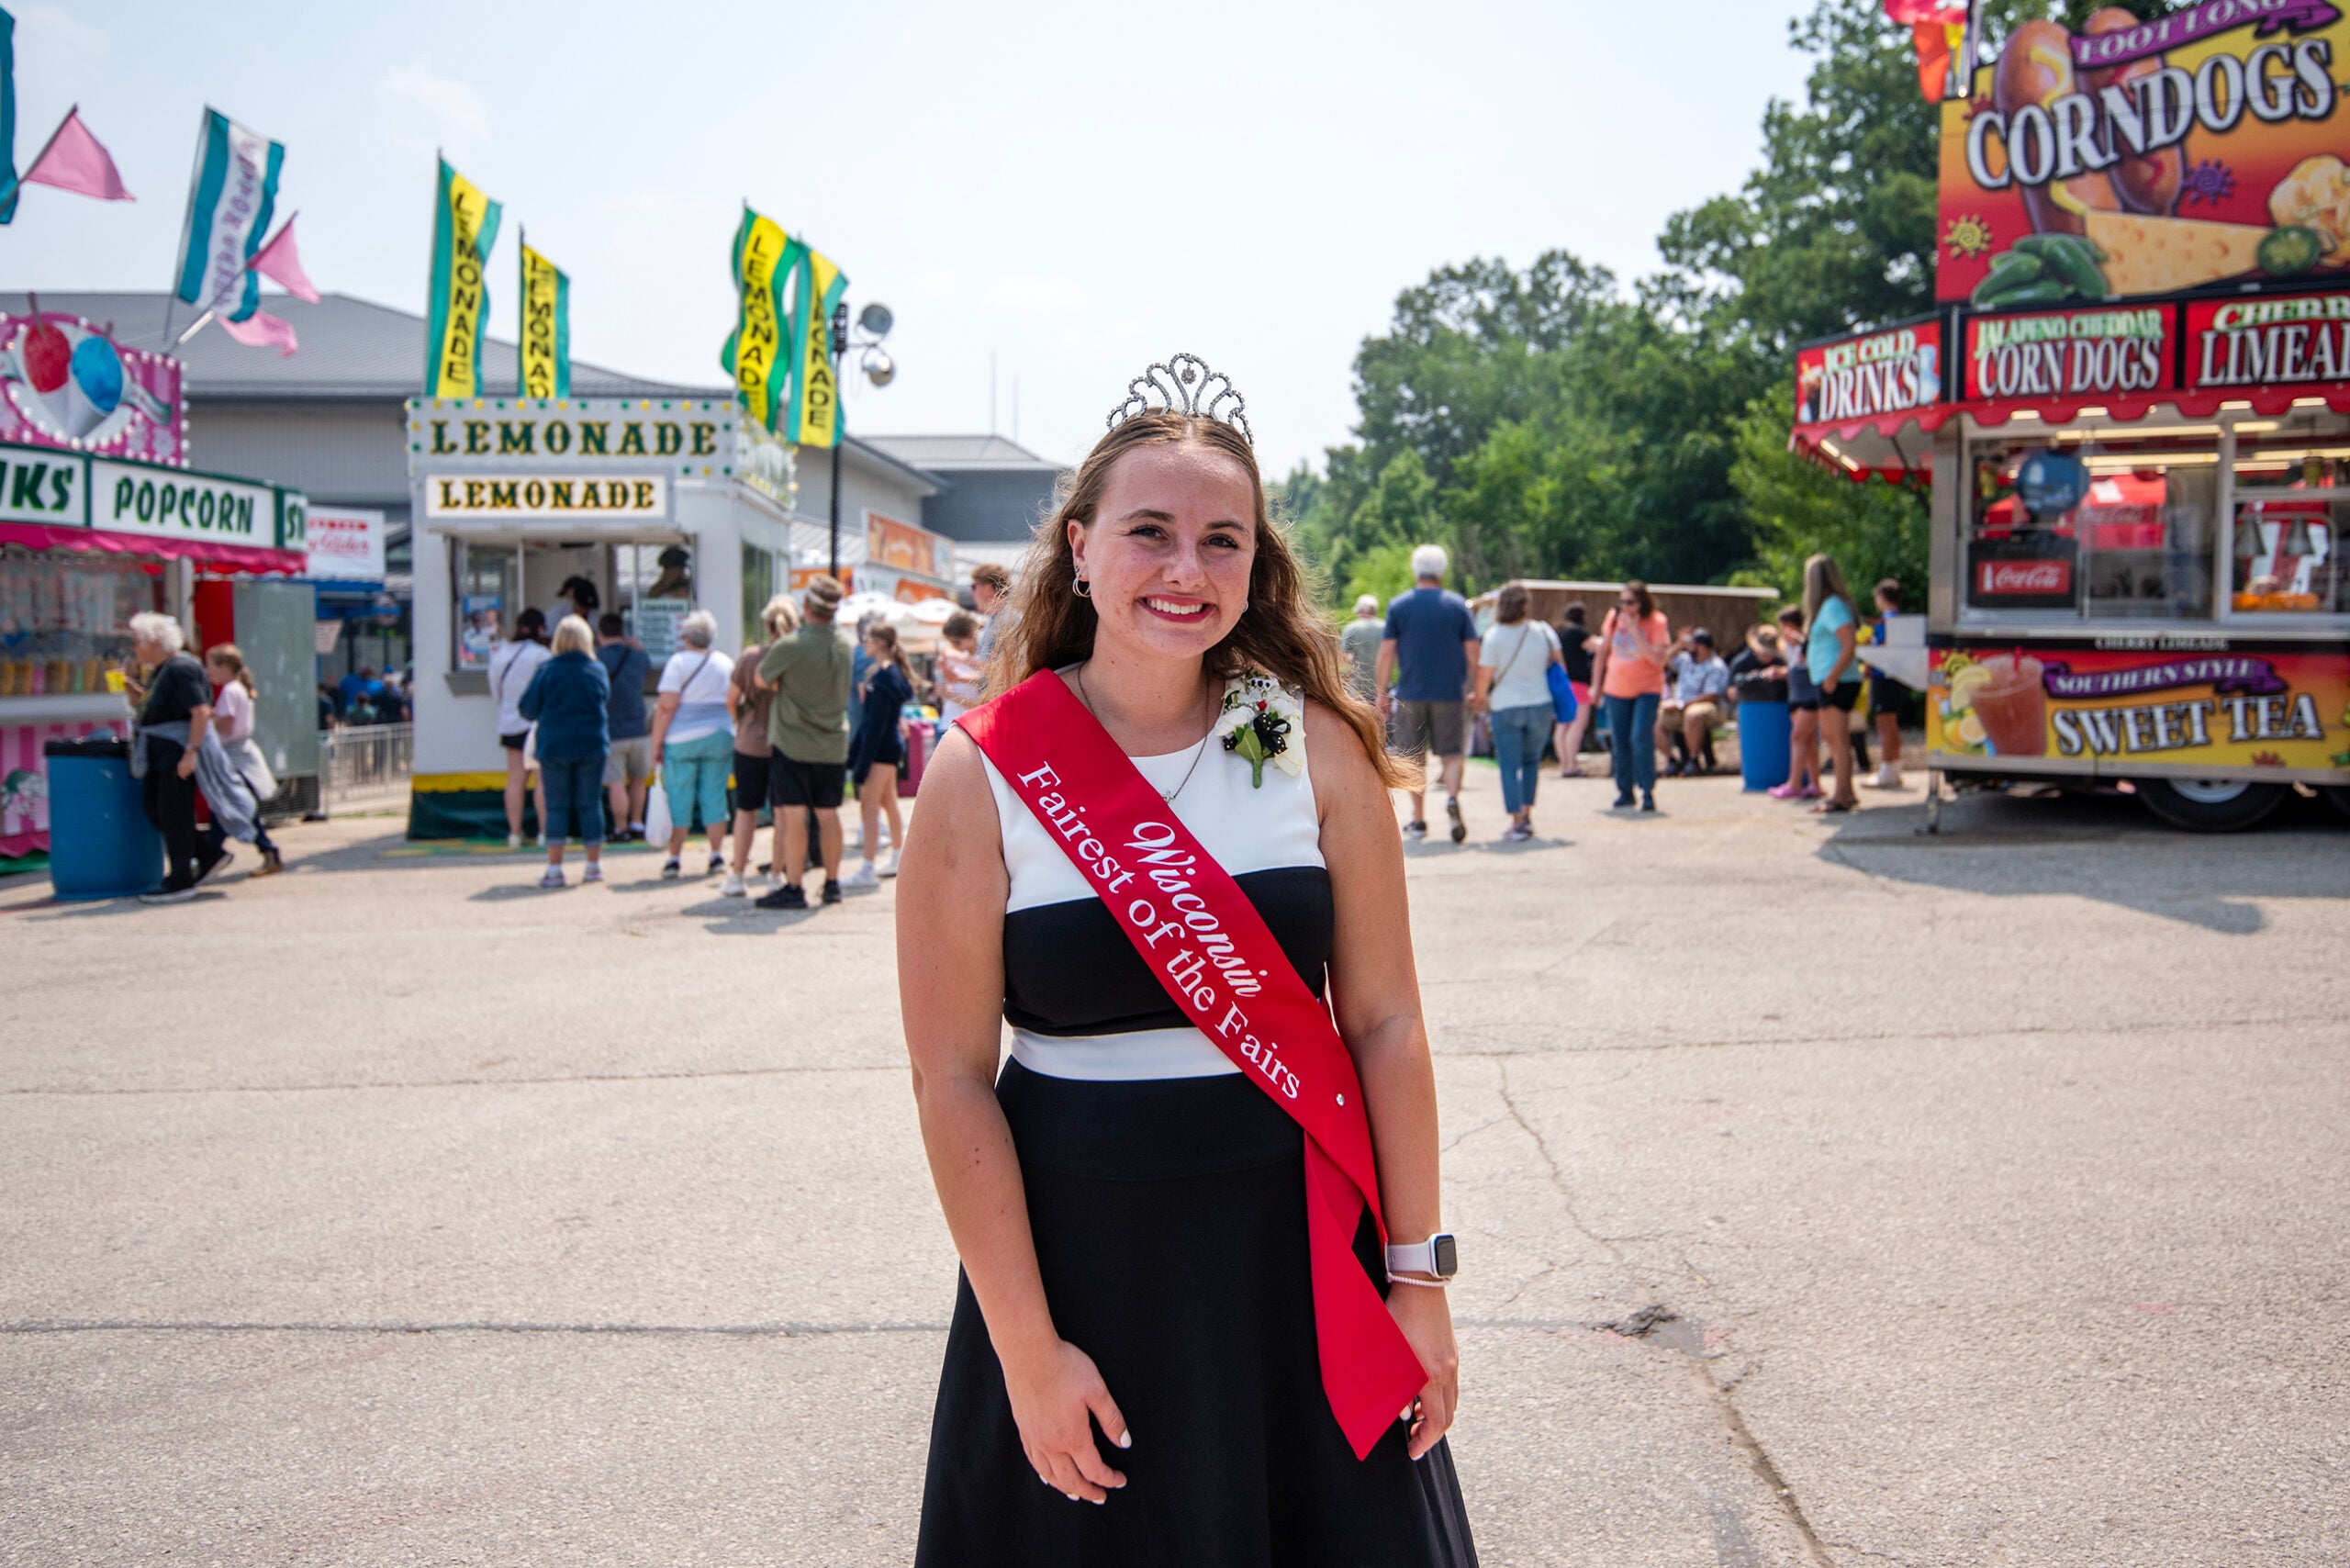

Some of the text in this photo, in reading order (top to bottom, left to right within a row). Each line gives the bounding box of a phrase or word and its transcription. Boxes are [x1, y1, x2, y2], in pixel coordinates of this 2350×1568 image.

[2079, 18, 2178, 63] FOOT
[1965, 39, 2333, 189] CORNDOGS
[447, 192, 482, 386] LEMONADE
[1859, 329, 1917, 364] COLD
[1977, 336, 2161, 398] CORN DOGS
[1818, 353, 1919, 421] DRINKS
[429, 419, 718, 456] LEMONADE
[114, 476, 254, 535] POPCORN
[438, 479, 655, 510] LEMONADE
[2054, 658, 2256, 694] SOUTHERN STYLE
[2053, 693, 2325, 755] SWEET TEA
[1016, 760, 1301, 1100] Fairest of the Fairs
[1123, 821, 1269, 998] Wisconsin
